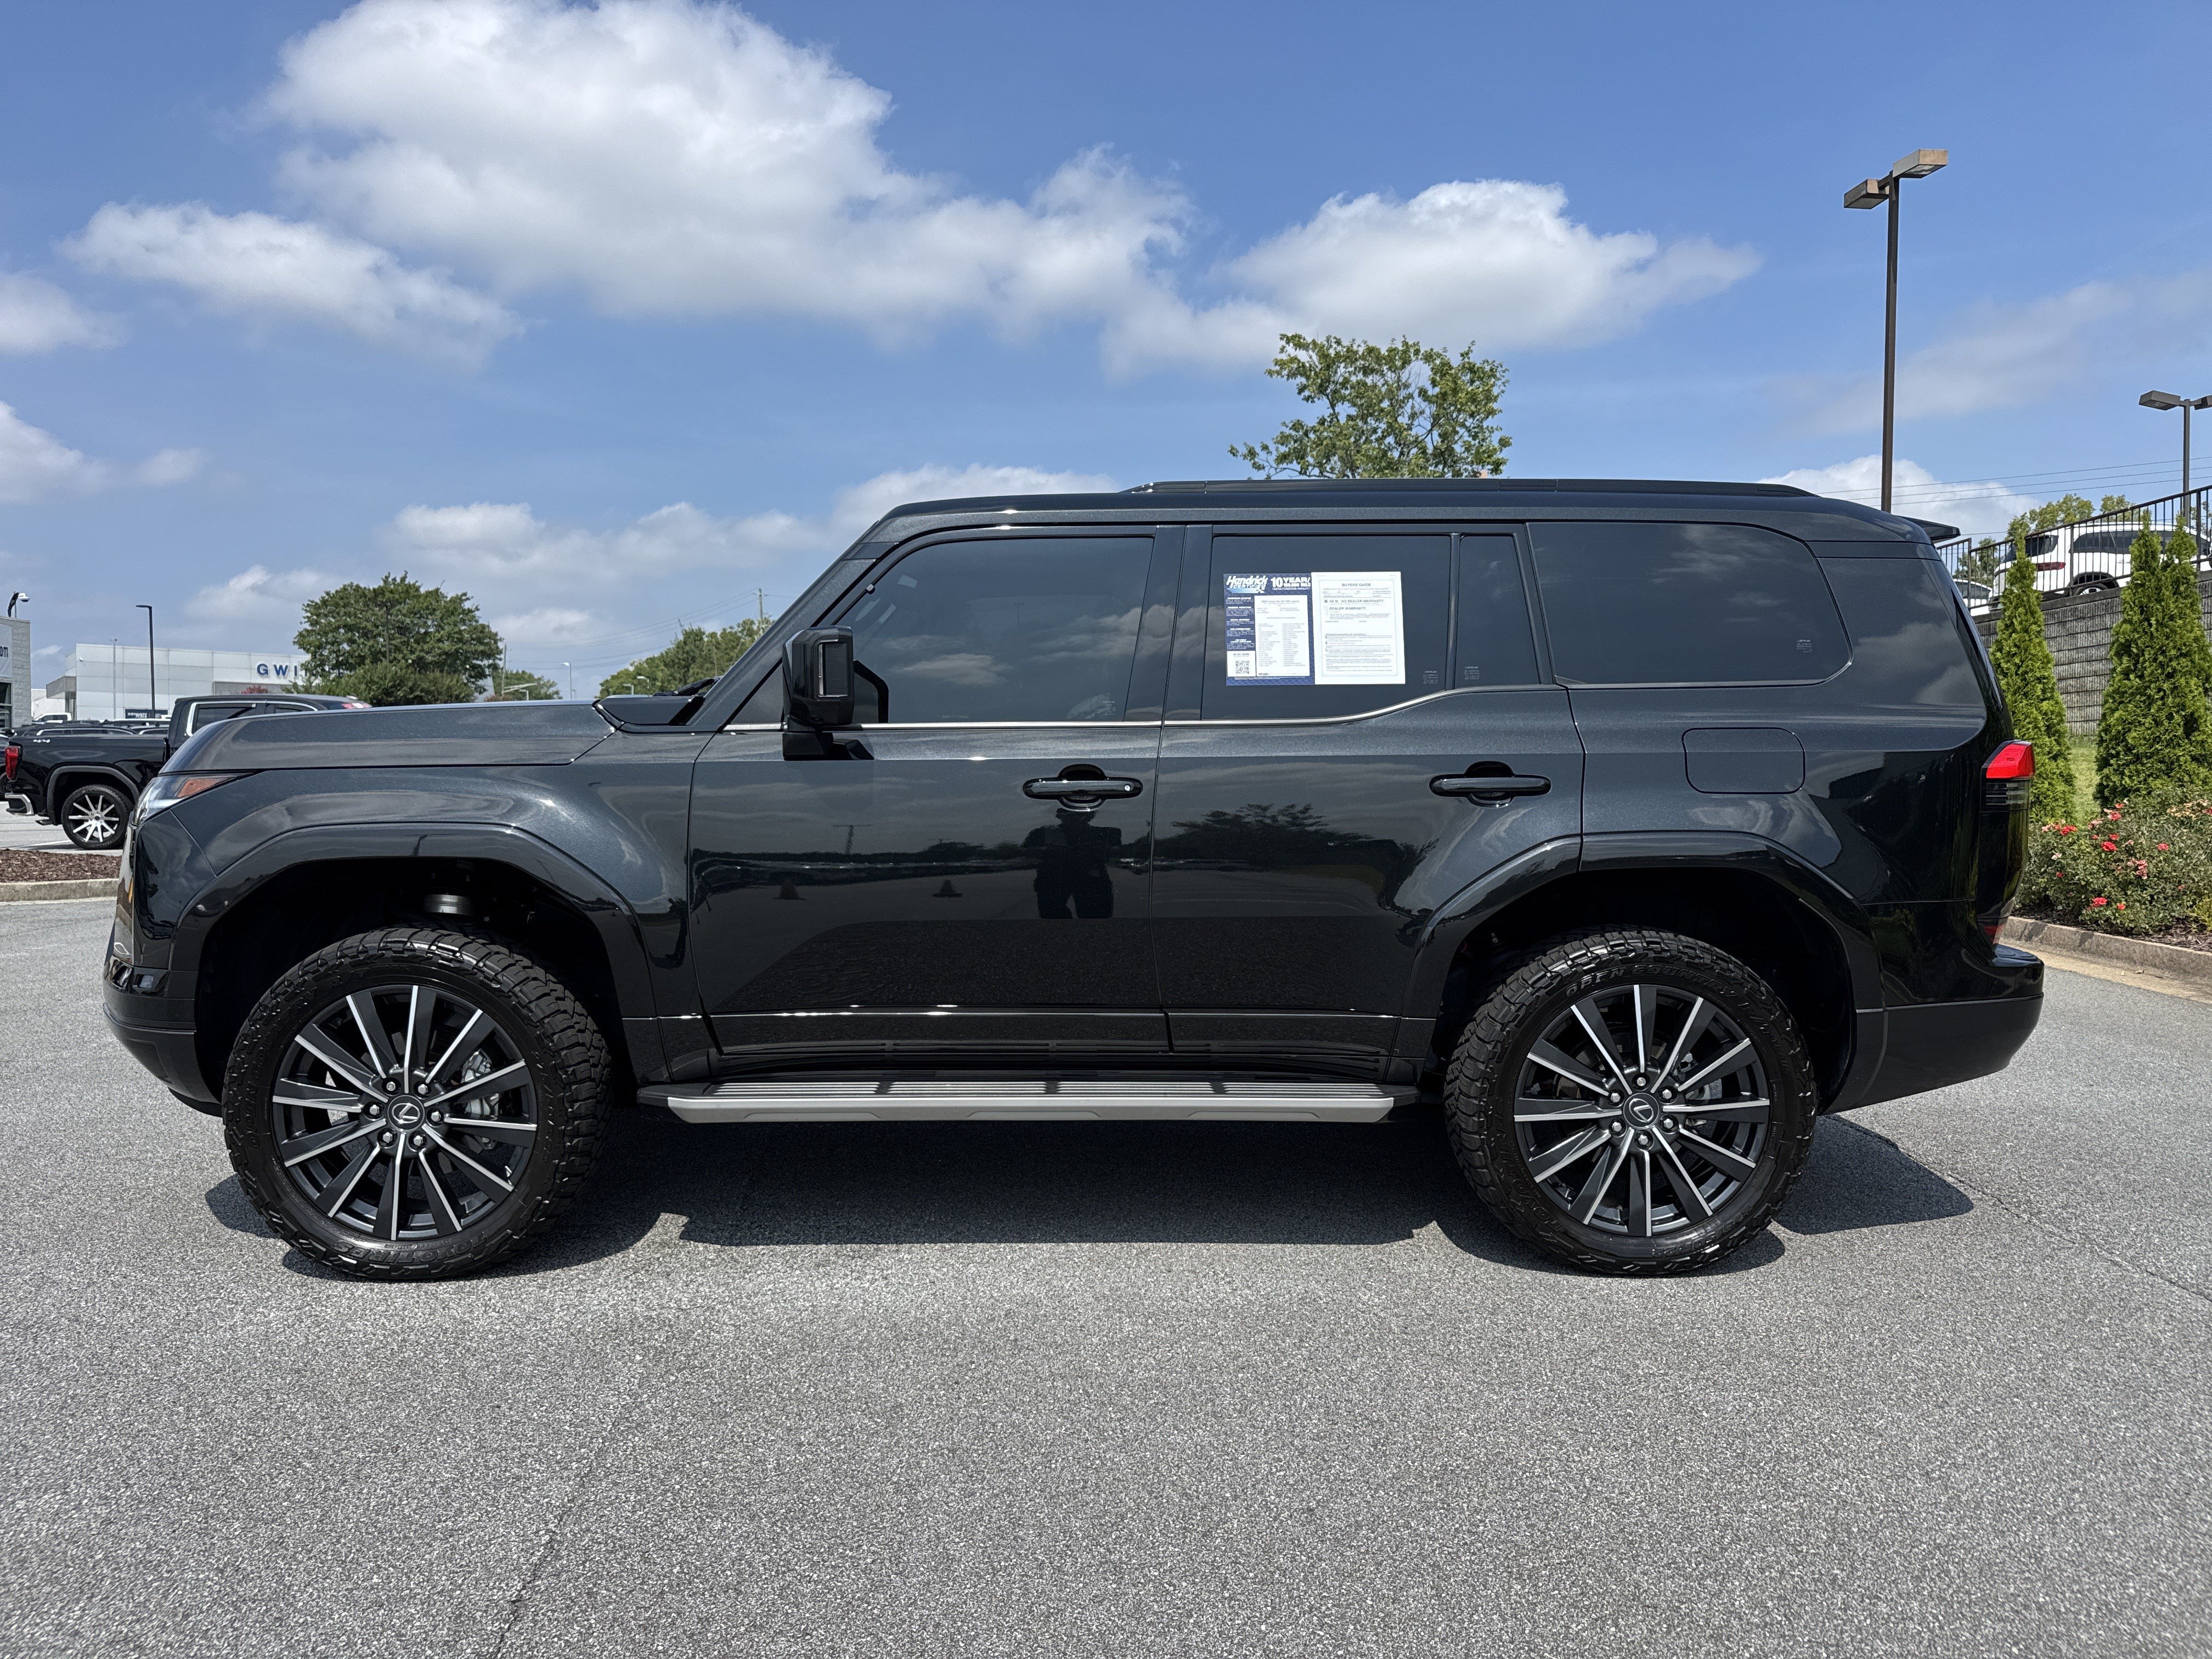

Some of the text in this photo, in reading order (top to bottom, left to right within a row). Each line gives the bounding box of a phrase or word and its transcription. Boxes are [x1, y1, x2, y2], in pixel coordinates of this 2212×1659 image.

[1226, 575, 1268, 588] Hendrick
[1271, 577, 1283, 588] 10
[1565, 966, 1627, 998] OPEN
[1630, 964, 1738, 997] COUNTRY
[245, 1081, 260, 1148] OPEN
[1513, 1178, 1563, 1233] TOYO
[333, 1240, 420, 1263] TIRES
[420, 1231, 488, 1262] TOYO
